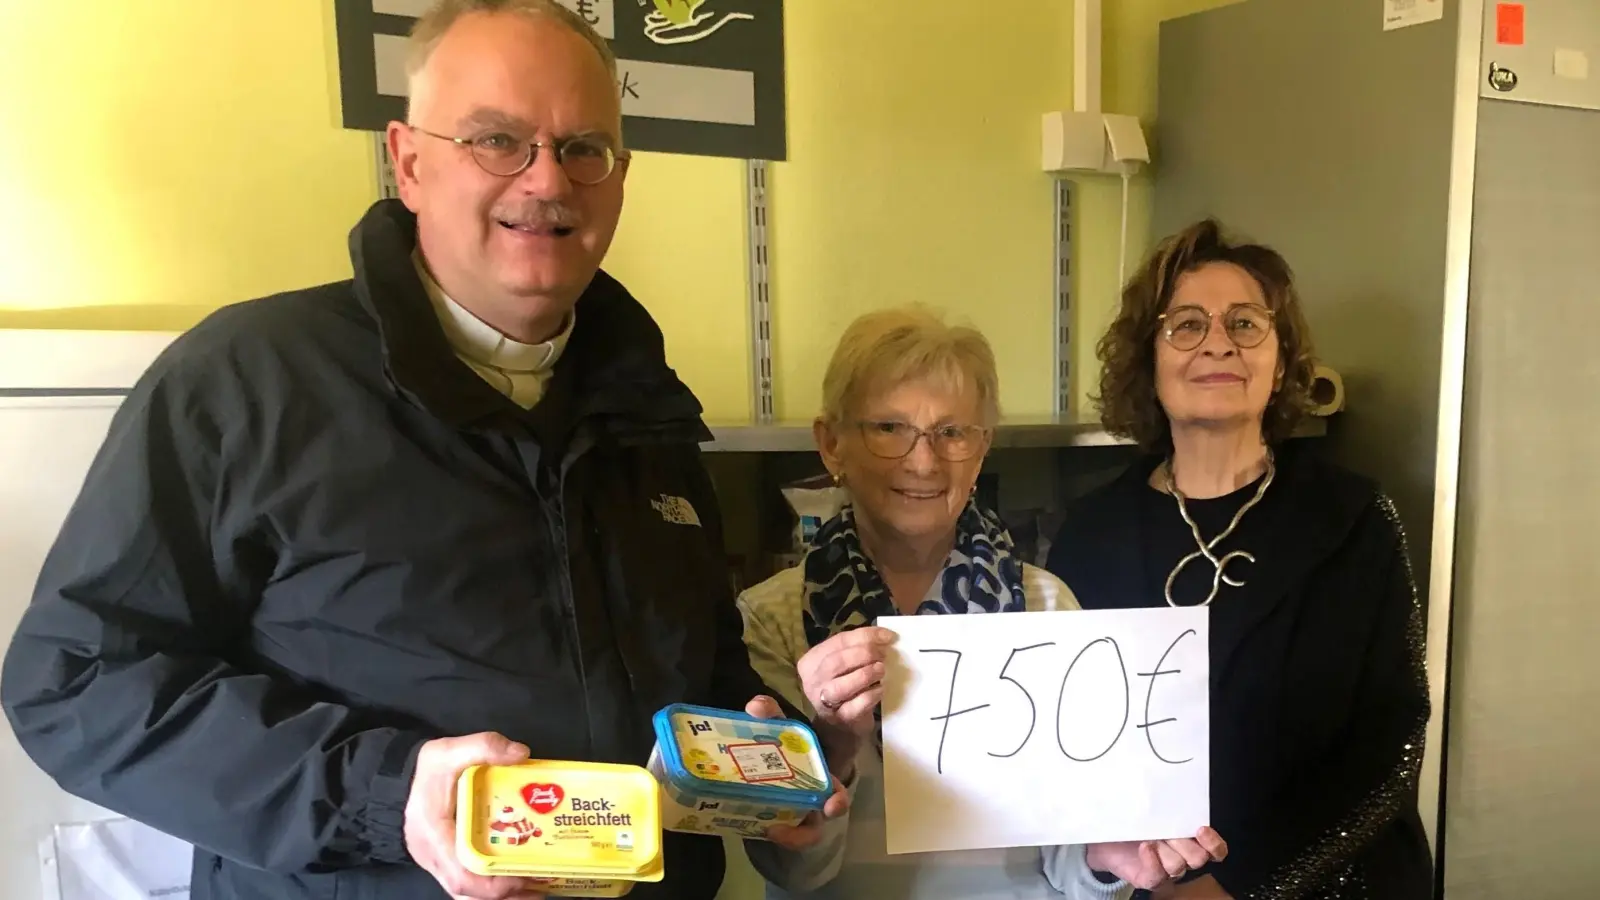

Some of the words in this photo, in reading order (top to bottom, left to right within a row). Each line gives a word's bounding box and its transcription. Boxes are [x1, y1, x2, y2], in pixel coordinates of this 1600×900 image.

[650, 498, 681, 515] NORTH
[659, 493, 678, 506] THE
[662, 512, 686, 525] FACE
[687, 719, 712, 736] ja!
[571, 798, 616, 811] Back-
[553, 812, 632, 827] streichfett
